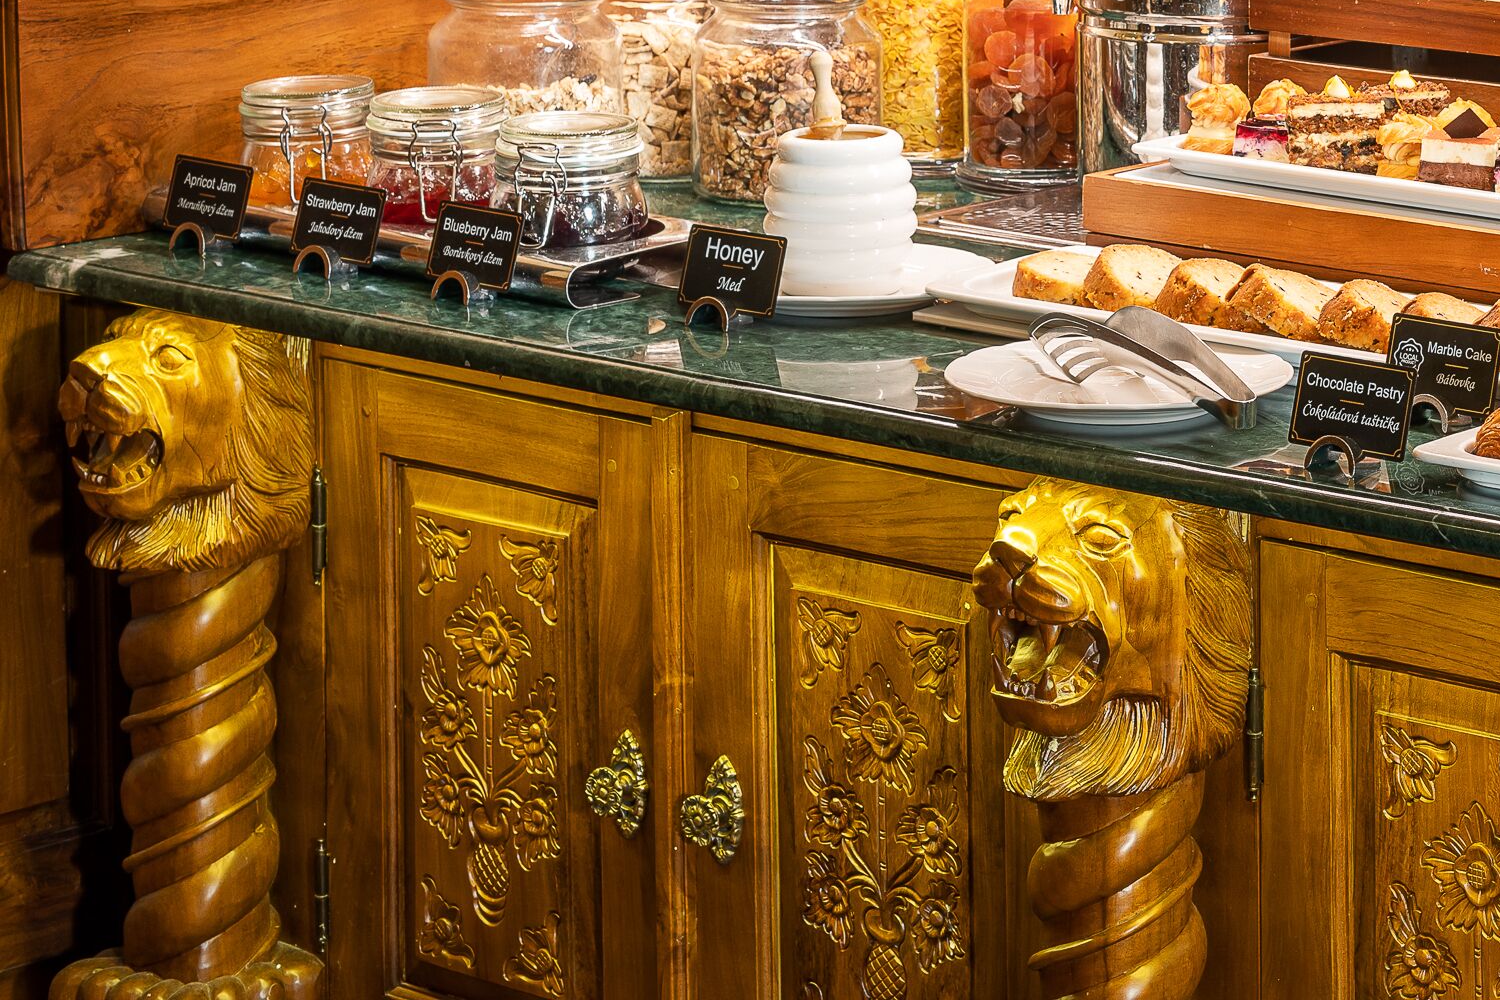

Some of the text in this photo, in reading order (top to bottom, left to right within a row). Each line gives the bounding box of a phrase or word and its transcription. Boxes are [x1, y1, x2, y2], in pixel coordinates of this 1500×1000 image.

[184, 172, 237, 193] Apricot Jam
[177, 197, 235, 218] Meruňkový džem
[306, 193, 377, 217] Strawberry Jam
[308, 221, 364, 240] Jahodový džem
[443, 217, 512, 242] Blueberry Jam
[443, 245, 503, 266] Borůvkový džem
[705, 236, 765, 271] Honey
[716, 276, 746, 292] Med
[1399, 352, 1419, 362] LOCAL
[1427, 341, 1492, 362] Marble Cake
[1306, 372, 1405, 404] Chocolate Pastry
[1436, 373, 1476, 392] Bábovka
[1302, 400, 1400, 434] Čokoládová taštička
